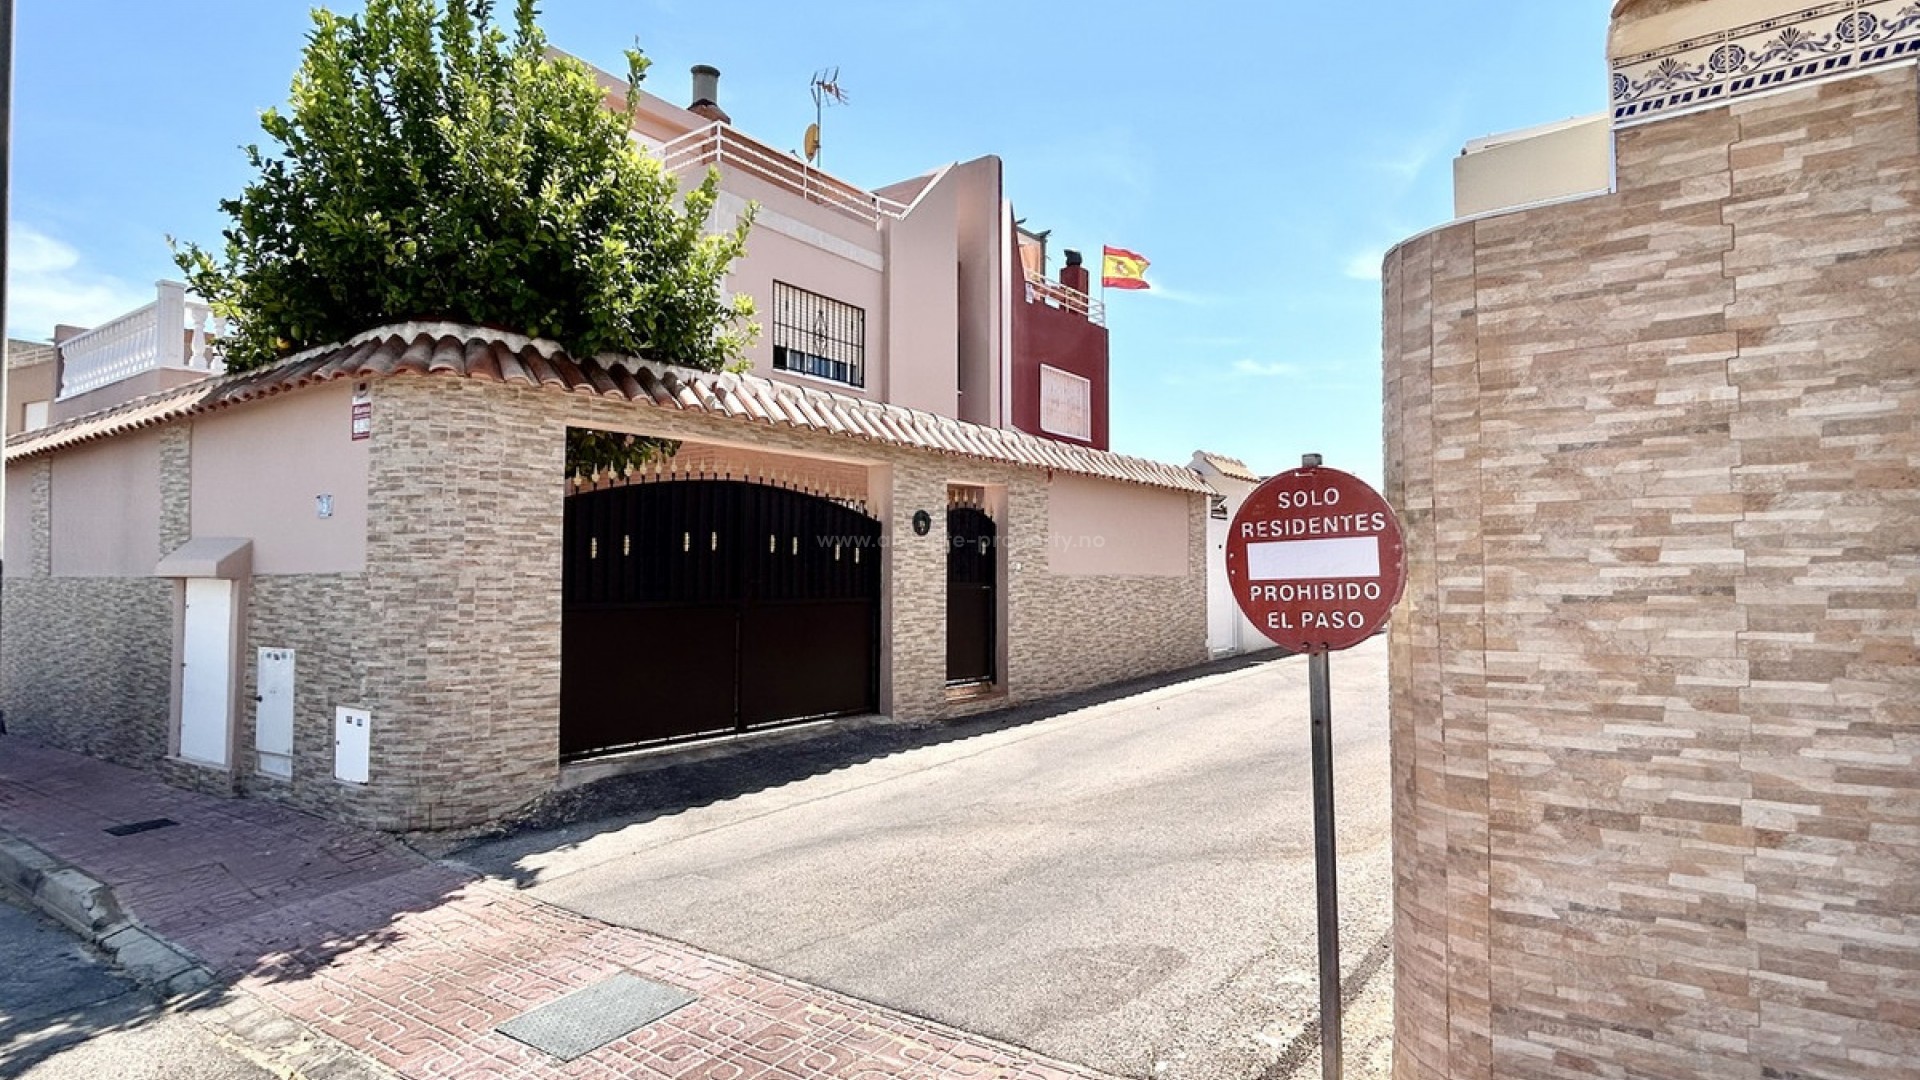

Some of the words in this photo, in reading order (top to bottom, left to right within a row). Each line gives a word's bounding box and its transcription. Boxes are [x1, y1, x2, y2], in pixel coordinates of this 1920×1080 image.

[1278, 488, 1340, 508] SOLO
[1241, 513, 1387, 538] RESIDENTES
[1250, 582, 1381, 602] PROHIBIDO
[1268, 611, 1293, 629] EL
[1302, 611, 1364, 629] PASO
